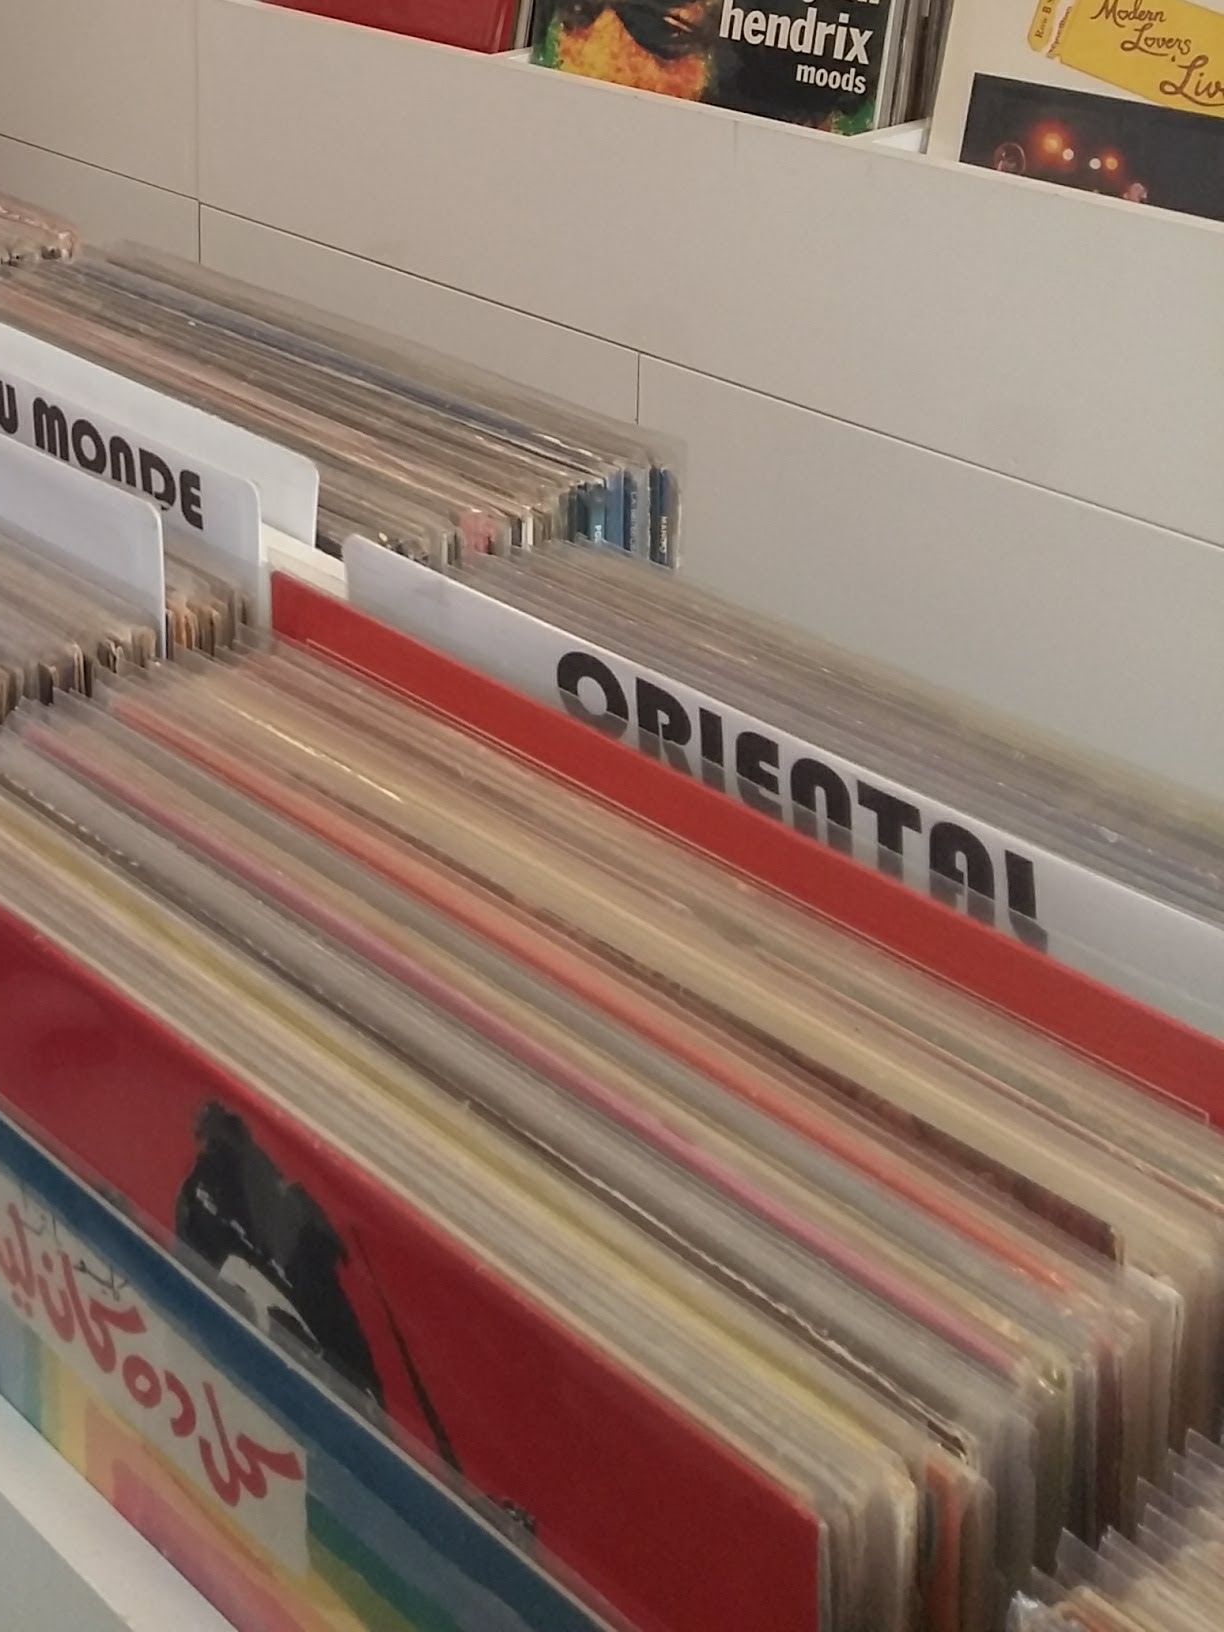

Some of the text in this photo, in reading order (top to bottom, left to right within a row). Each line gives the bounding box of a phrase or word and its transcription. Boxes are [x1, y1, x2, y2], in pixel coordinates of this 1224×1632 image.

[795, 63, 867, 95] moods
[1120, 23, 1192, 57] Lovers
[32, 397, 204, 531] MONDE
[556, 650, 1048, 954] ORIENTAL
